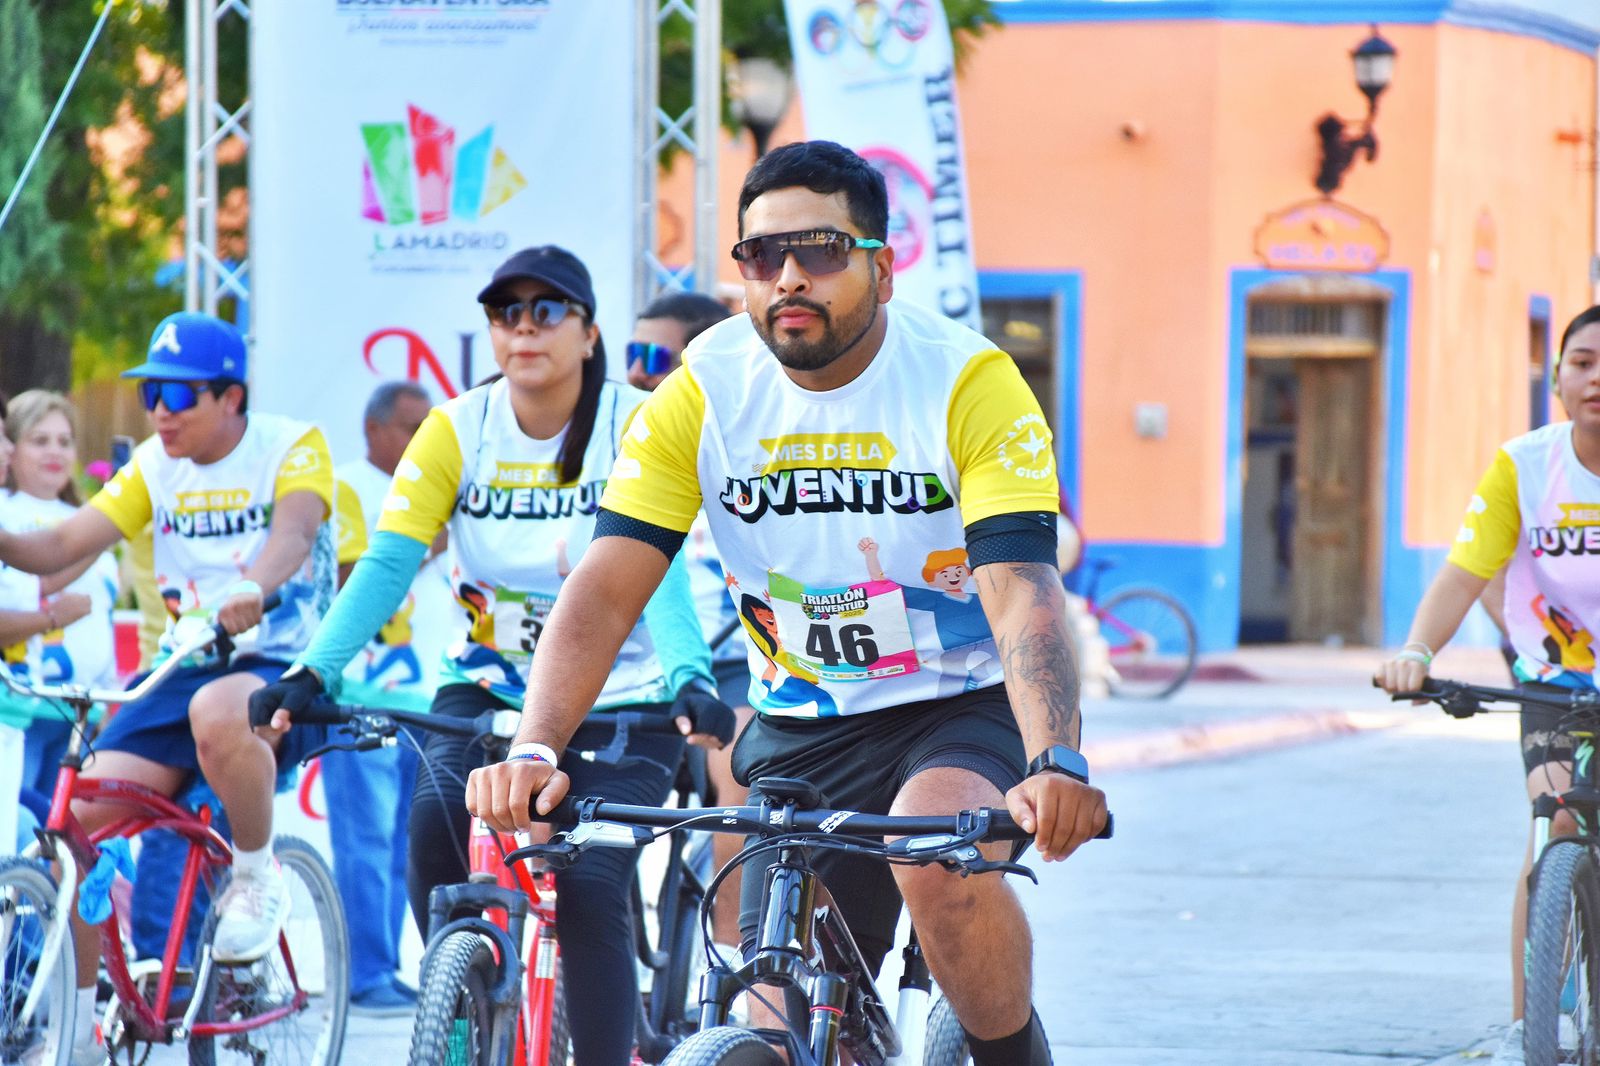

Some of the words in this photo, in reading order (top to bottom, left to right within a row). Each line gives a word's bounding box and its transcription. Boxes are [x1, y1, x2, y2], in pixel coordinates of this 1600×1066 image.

[372, 232, 508, 251] LAMADRID
[774, 443, 817, 462] MES
[823, 443, 852, 460] DE
[856, 443, 883, 460] LA
[499, 469, 534, 482] MES
[719, 467, 954, 524] JUVENTUD
[800, 587, 866, 606] TRIATLÓN
[812, 600, 867, 614] JUVENTUD
[806, 623, 880, 667] 46
